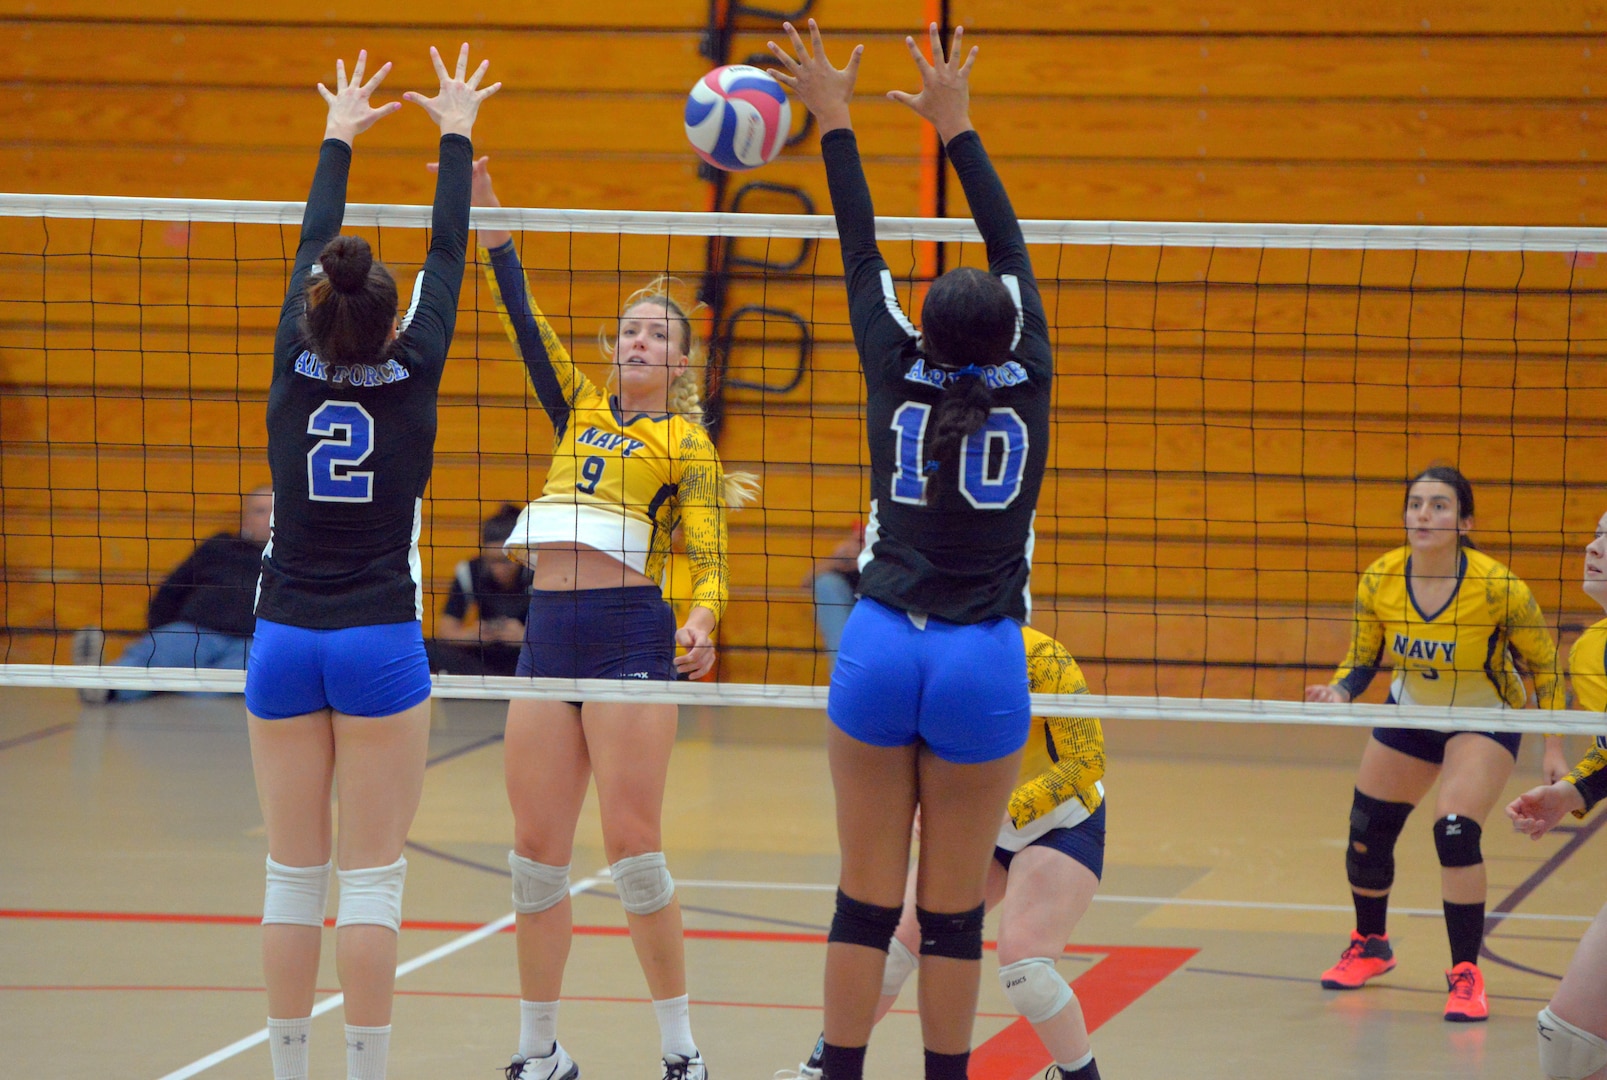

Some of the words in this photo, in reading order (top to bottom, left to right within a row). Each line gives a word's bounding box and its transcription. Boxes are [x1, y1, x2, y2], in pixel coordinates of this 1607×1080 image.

[294, 350, 328, 380] AIR
[333, 359, 410, 387] FORCE
[307, 400, 374, 503] 2
[577, 426, 646, 457] NAVY
[890, 401, 1029, 509] 10
[576, 455, 606, 495] 9
[1393, 633, 1456, 663] NAVY
